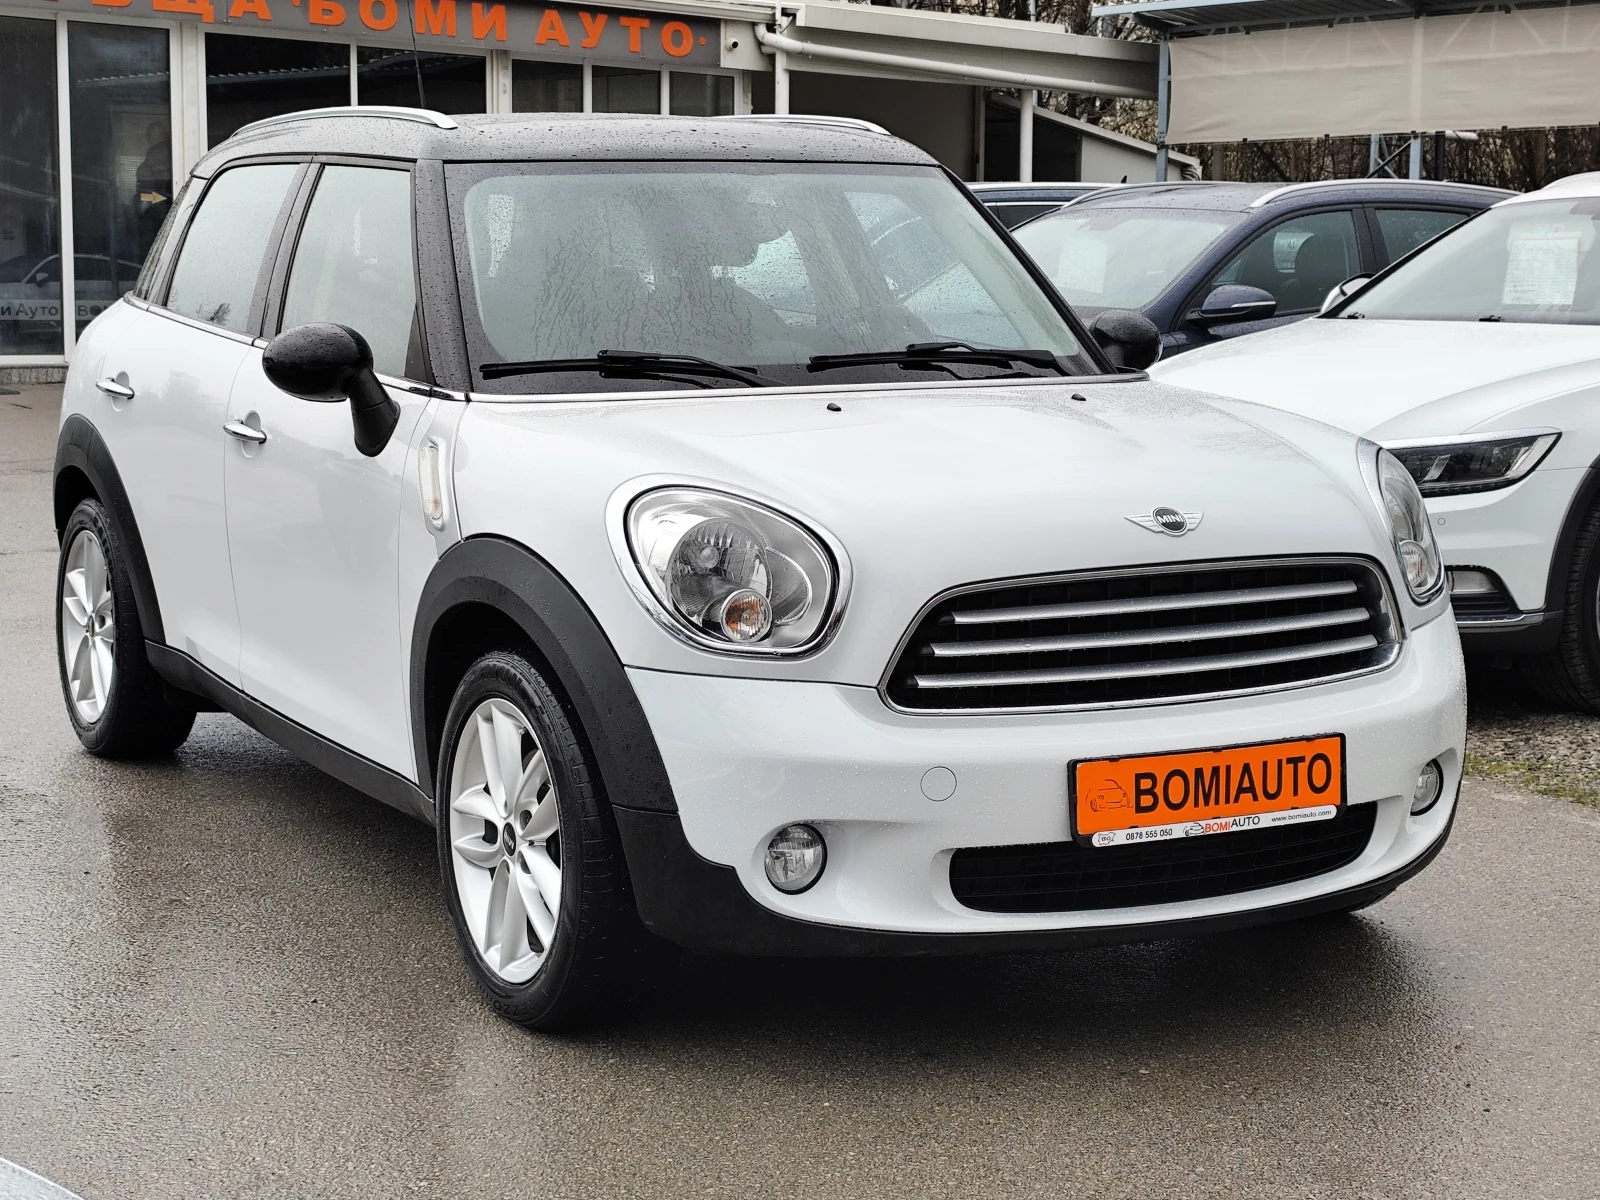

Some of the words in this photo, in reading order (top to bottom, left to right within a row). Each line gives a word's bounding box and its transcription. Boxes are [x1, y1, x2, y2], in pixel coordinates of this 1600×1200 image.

[535, 9, 694, 57] АУТО
[1157, 514, 1183, 523] MINI
[1134, 752, 1332, 814] BOMIAUTO
[1271, 810, 1332, 823] www.bomiauto.com
[1125, 831, 1143, 841] 0878
[1145, 829, 1158, 839] 555
[1159, 828, 1173, 837] 050
